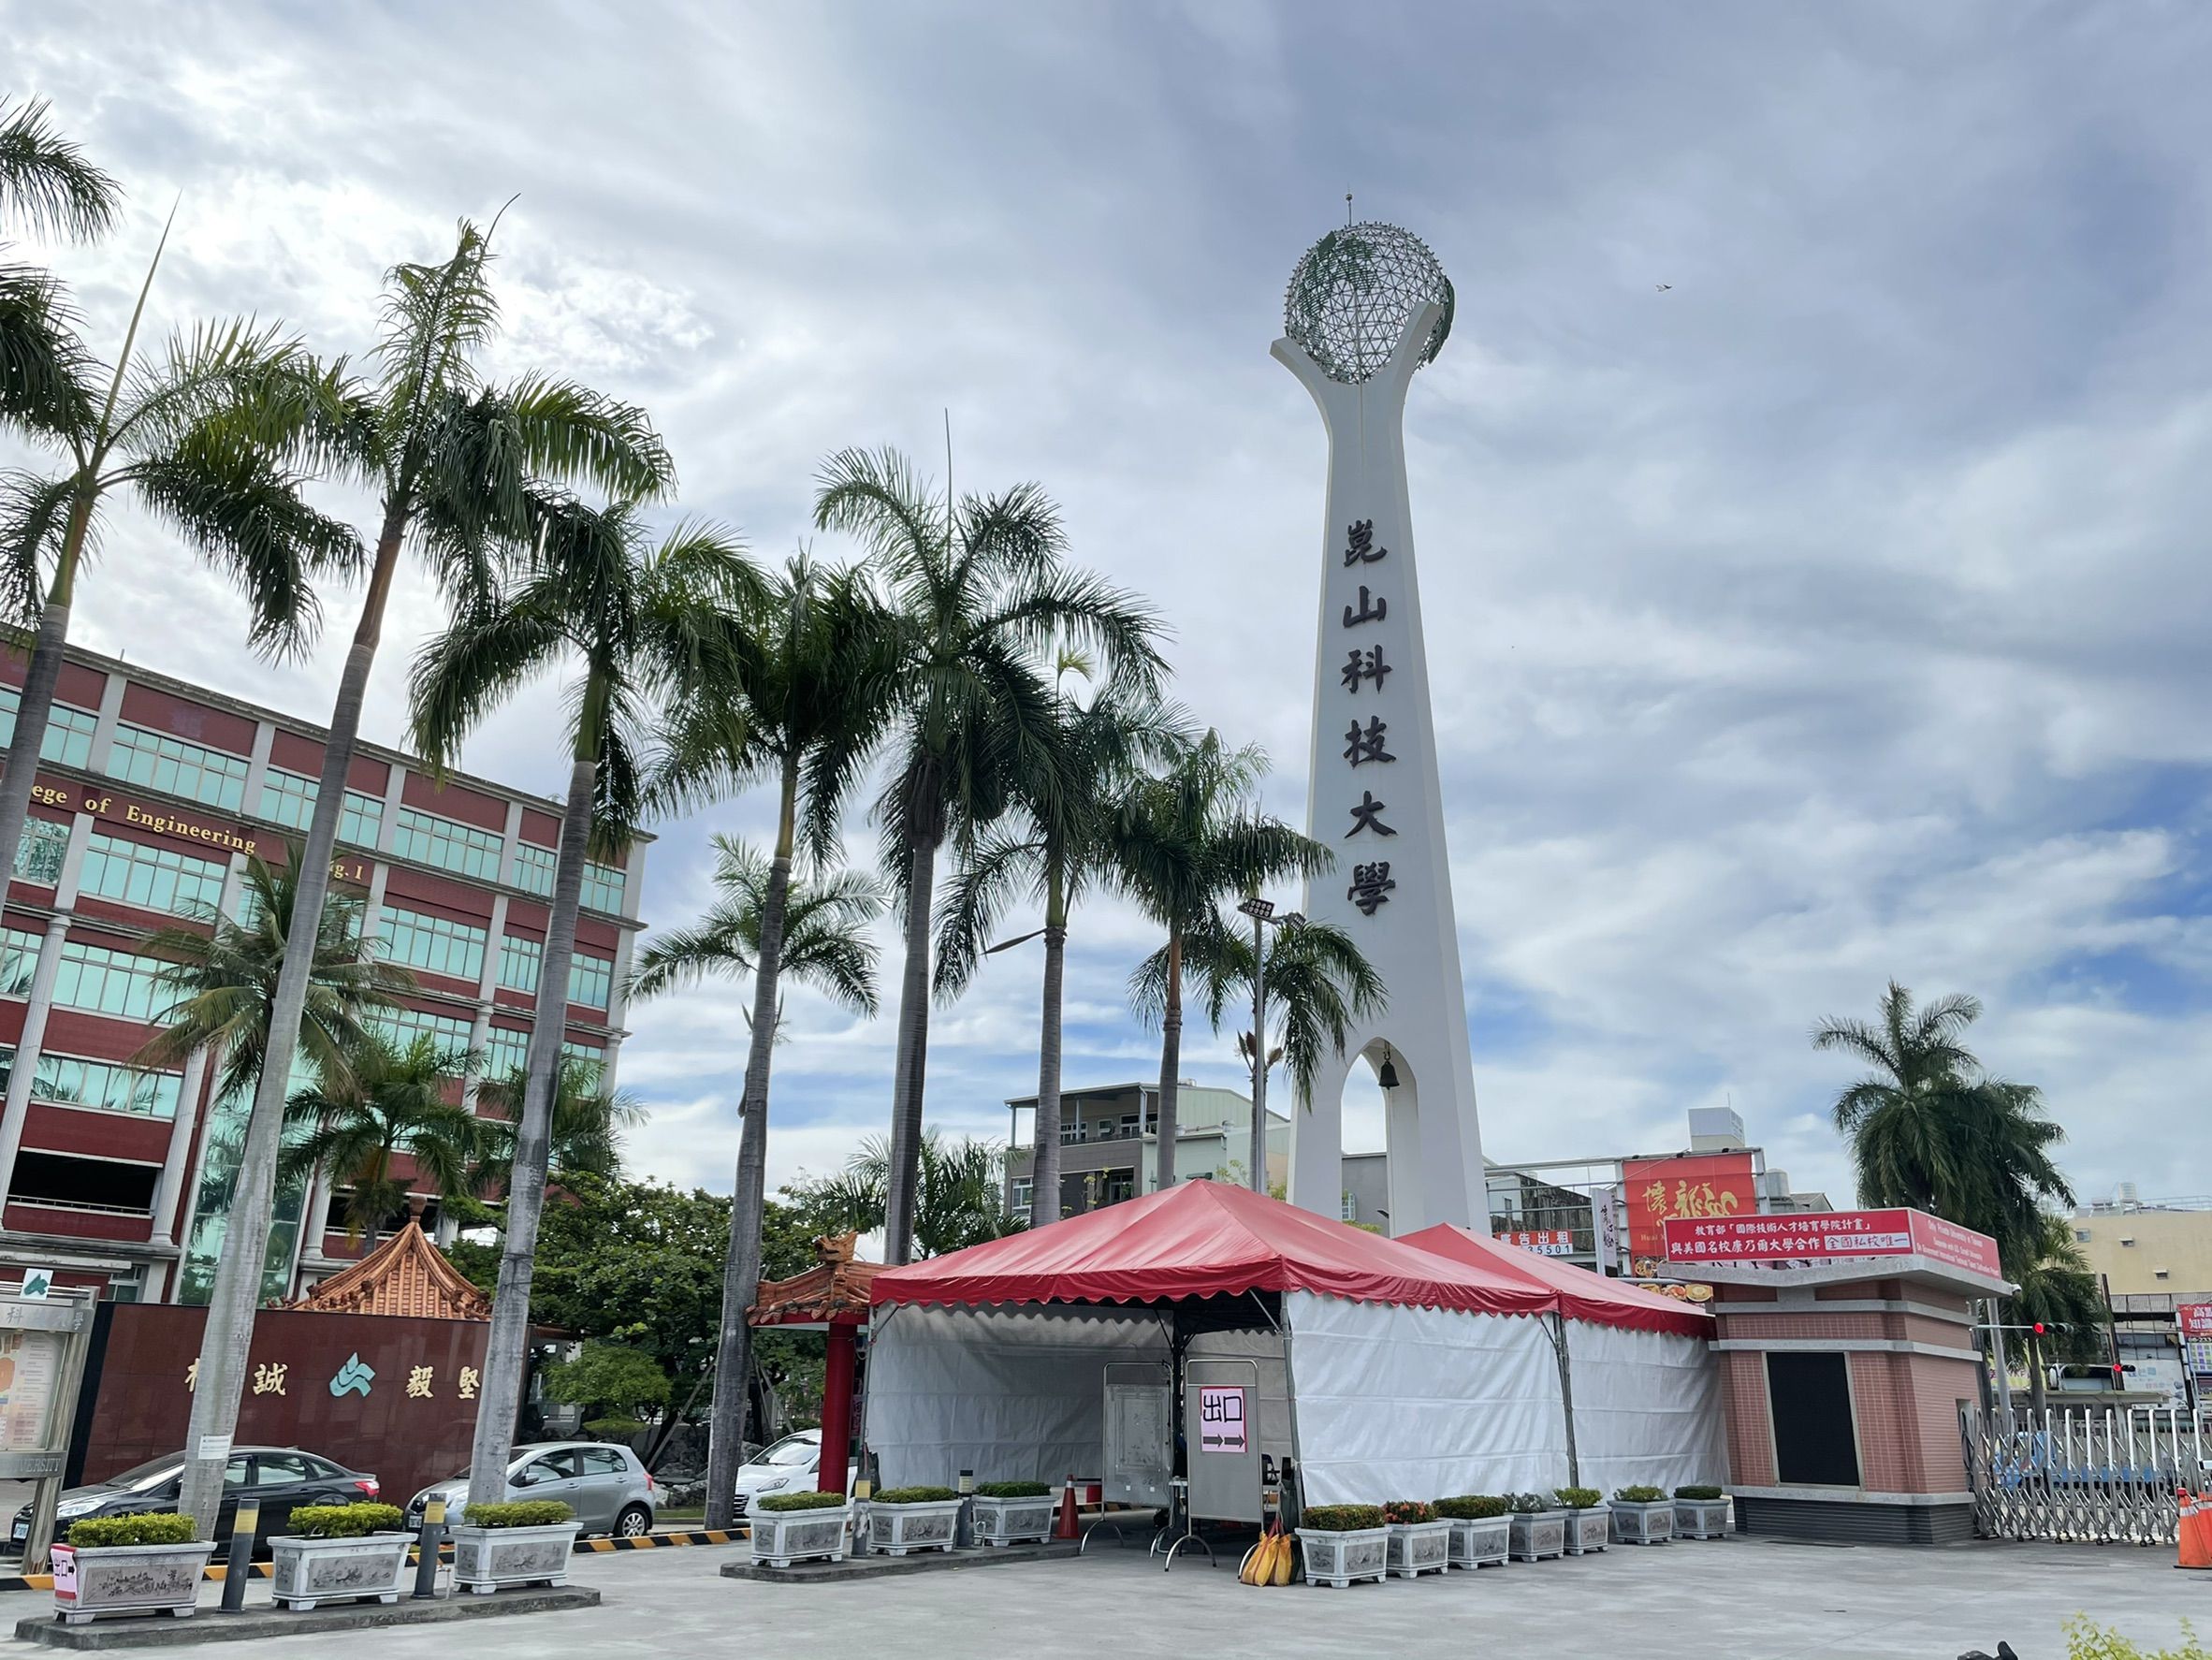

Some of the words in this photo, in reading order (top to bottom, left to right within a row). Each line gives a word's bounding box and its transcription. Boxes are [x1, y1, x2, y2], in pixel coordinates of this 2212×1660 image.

[1341, 518, 1400, 917] 崑山科技大學
[84, 797, 112, 814] of
[125, 804, 257, 855] Engineering
[1202, 1394, 1243, 1423] 出口
